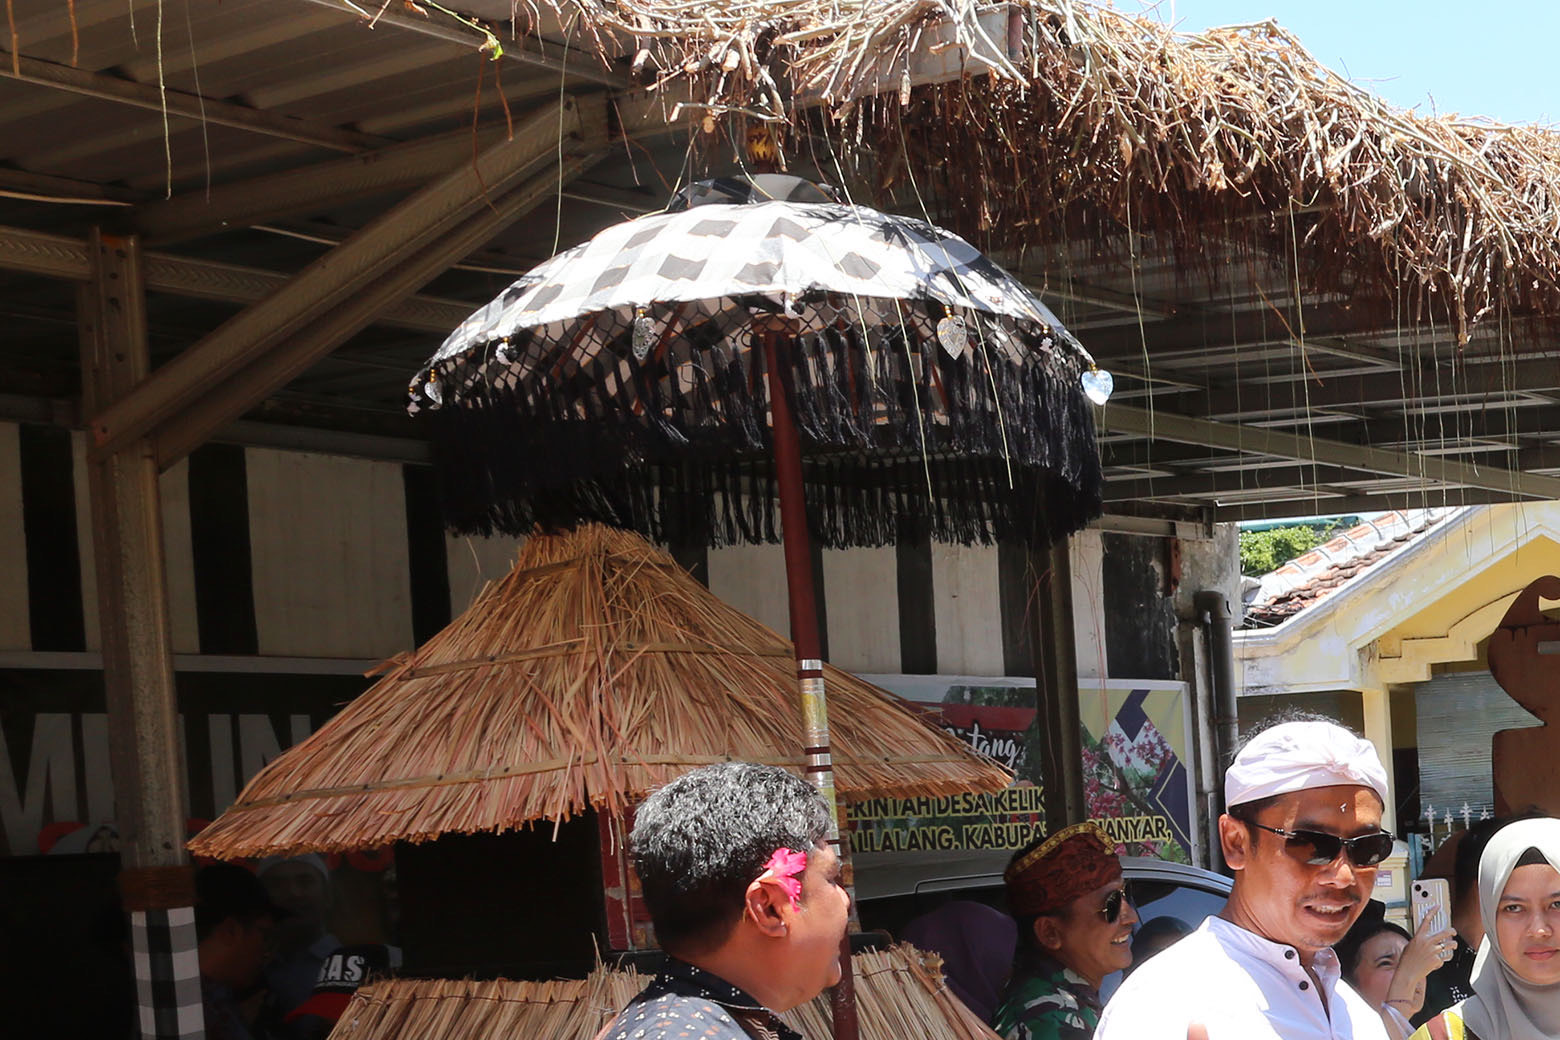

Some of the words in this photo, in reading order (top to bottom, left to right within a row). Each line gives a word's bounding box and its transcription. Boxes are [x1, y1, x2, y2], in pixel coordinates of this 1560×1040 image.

[935, 791, 992, 816] DESA
[961, 821, 1047, 850] KABUPA
[1087, 816, 1173, 843] IANYAR,
